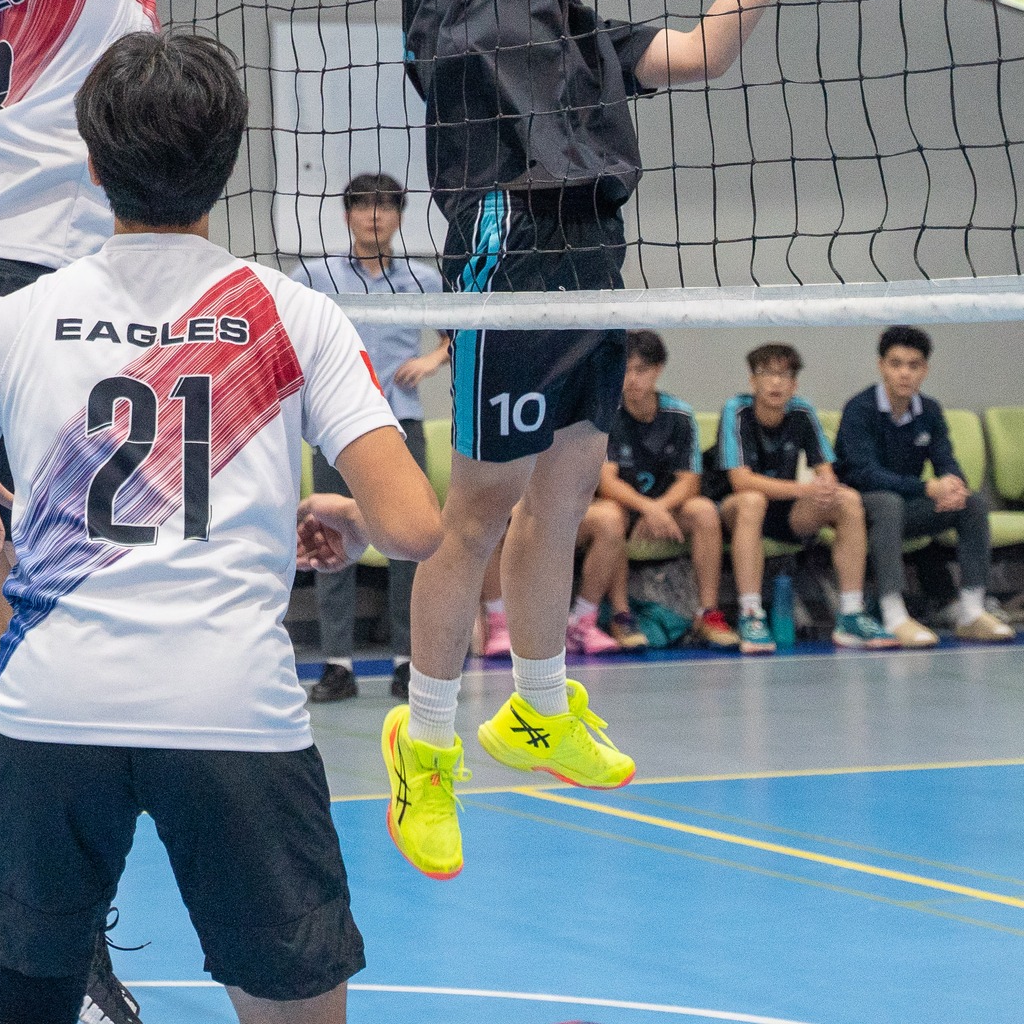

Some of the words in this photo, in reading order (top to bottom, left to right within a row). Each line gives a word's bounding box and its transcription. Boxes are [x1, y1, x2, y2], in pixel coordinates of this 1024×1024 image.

[54, 316, 250, 349] EAGLES
[489, 391, 546, 437] 10
[85, 374, 213, 546] 21
